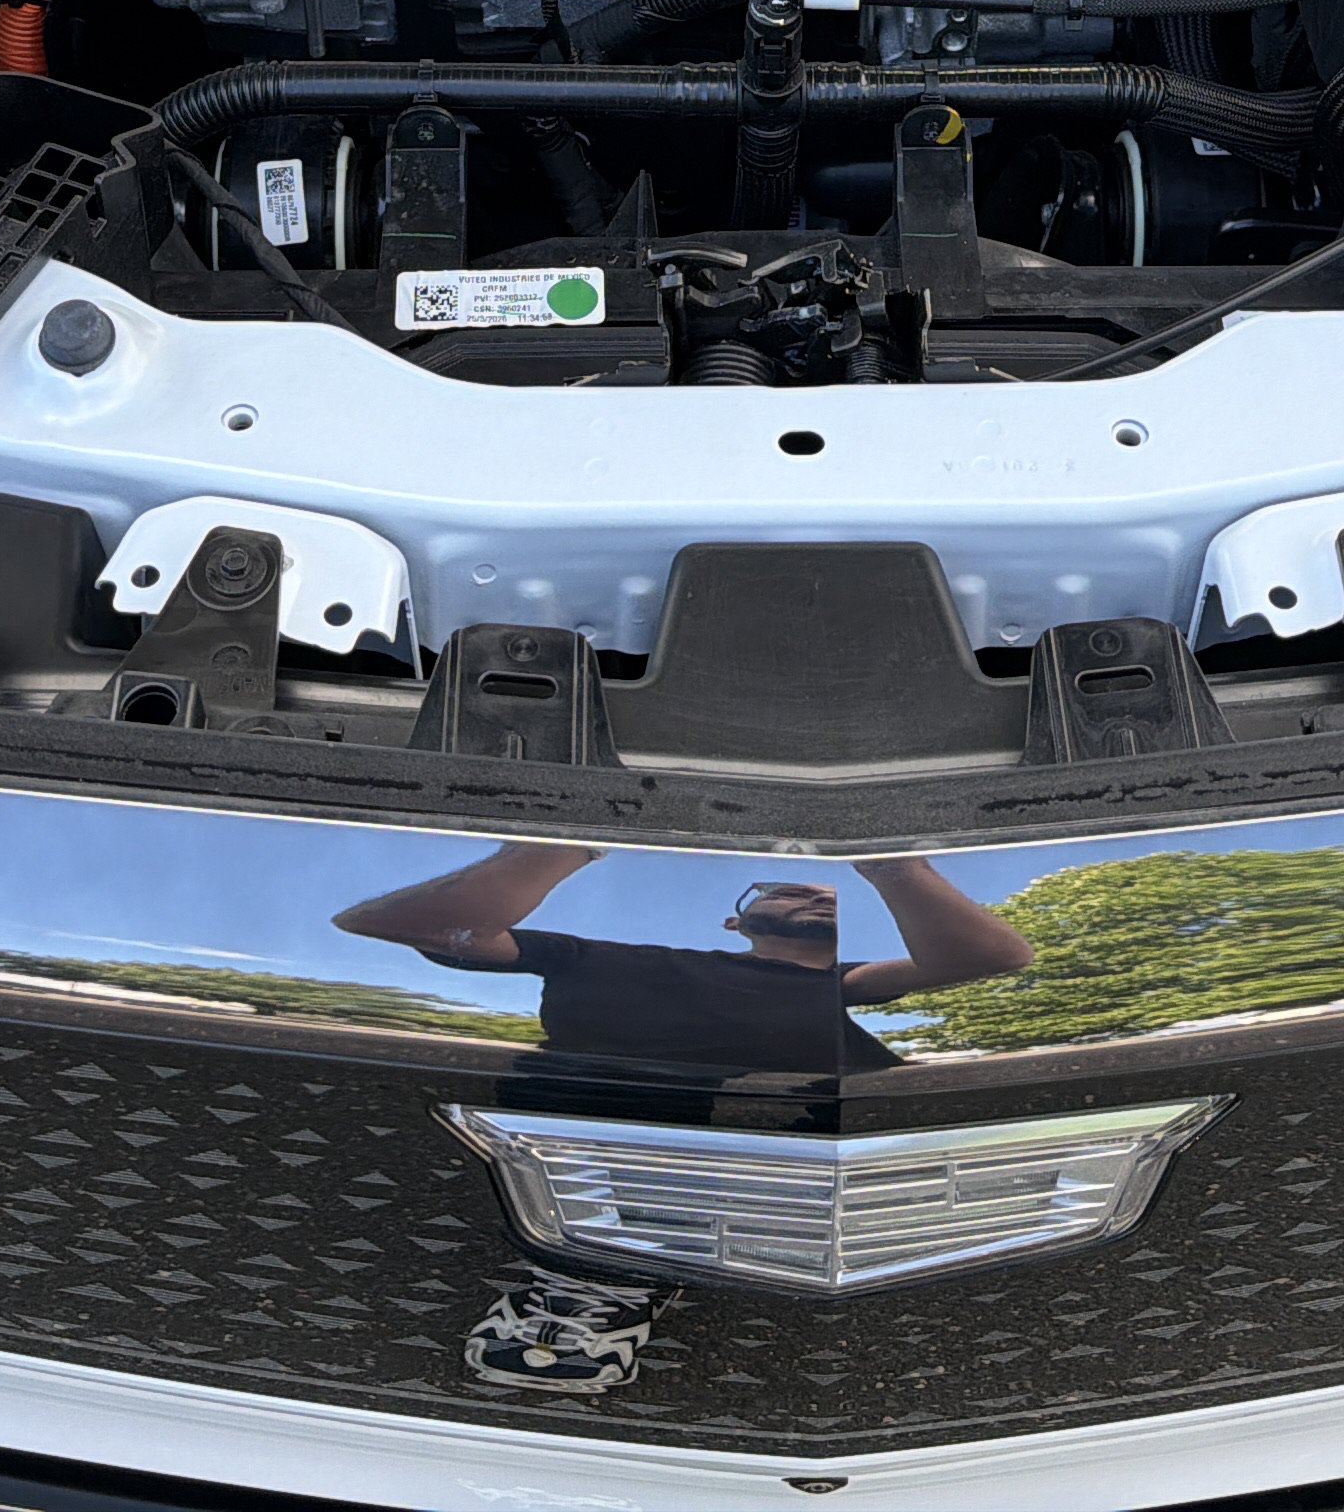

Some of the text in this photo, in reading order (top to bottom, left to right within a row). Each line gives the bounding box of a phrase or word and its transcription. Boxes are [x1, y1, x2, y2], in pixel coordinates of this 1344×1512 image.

[458, 272, 591, 284] VUTEQ INDUSTRIES DE MEXICO
